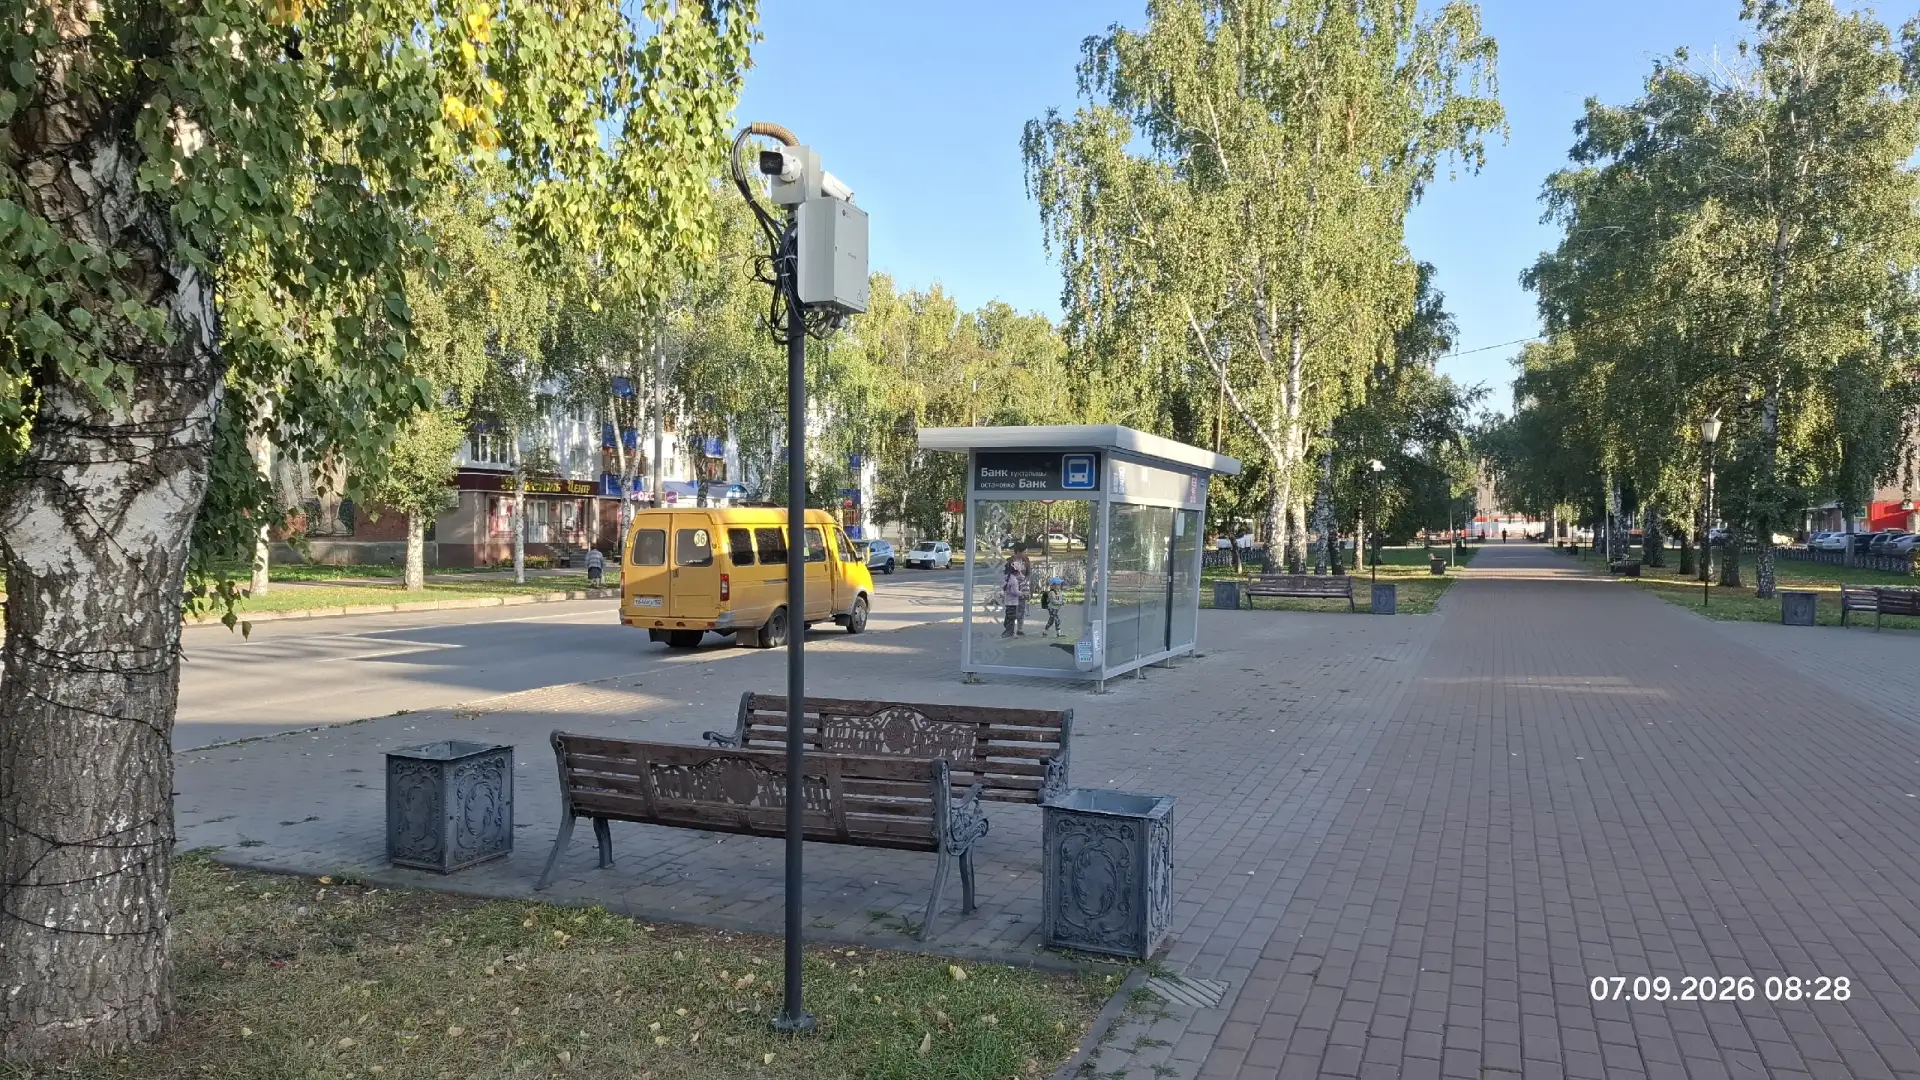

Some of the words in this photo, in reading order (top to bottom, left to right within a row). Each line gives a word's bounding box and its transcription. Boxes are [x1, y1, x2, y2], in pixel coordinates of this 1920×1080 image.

[981, 467, 1008, 477] Банк
[1019, 478, 1047, 489] Банк
[695, 533, 706, 545] 36
